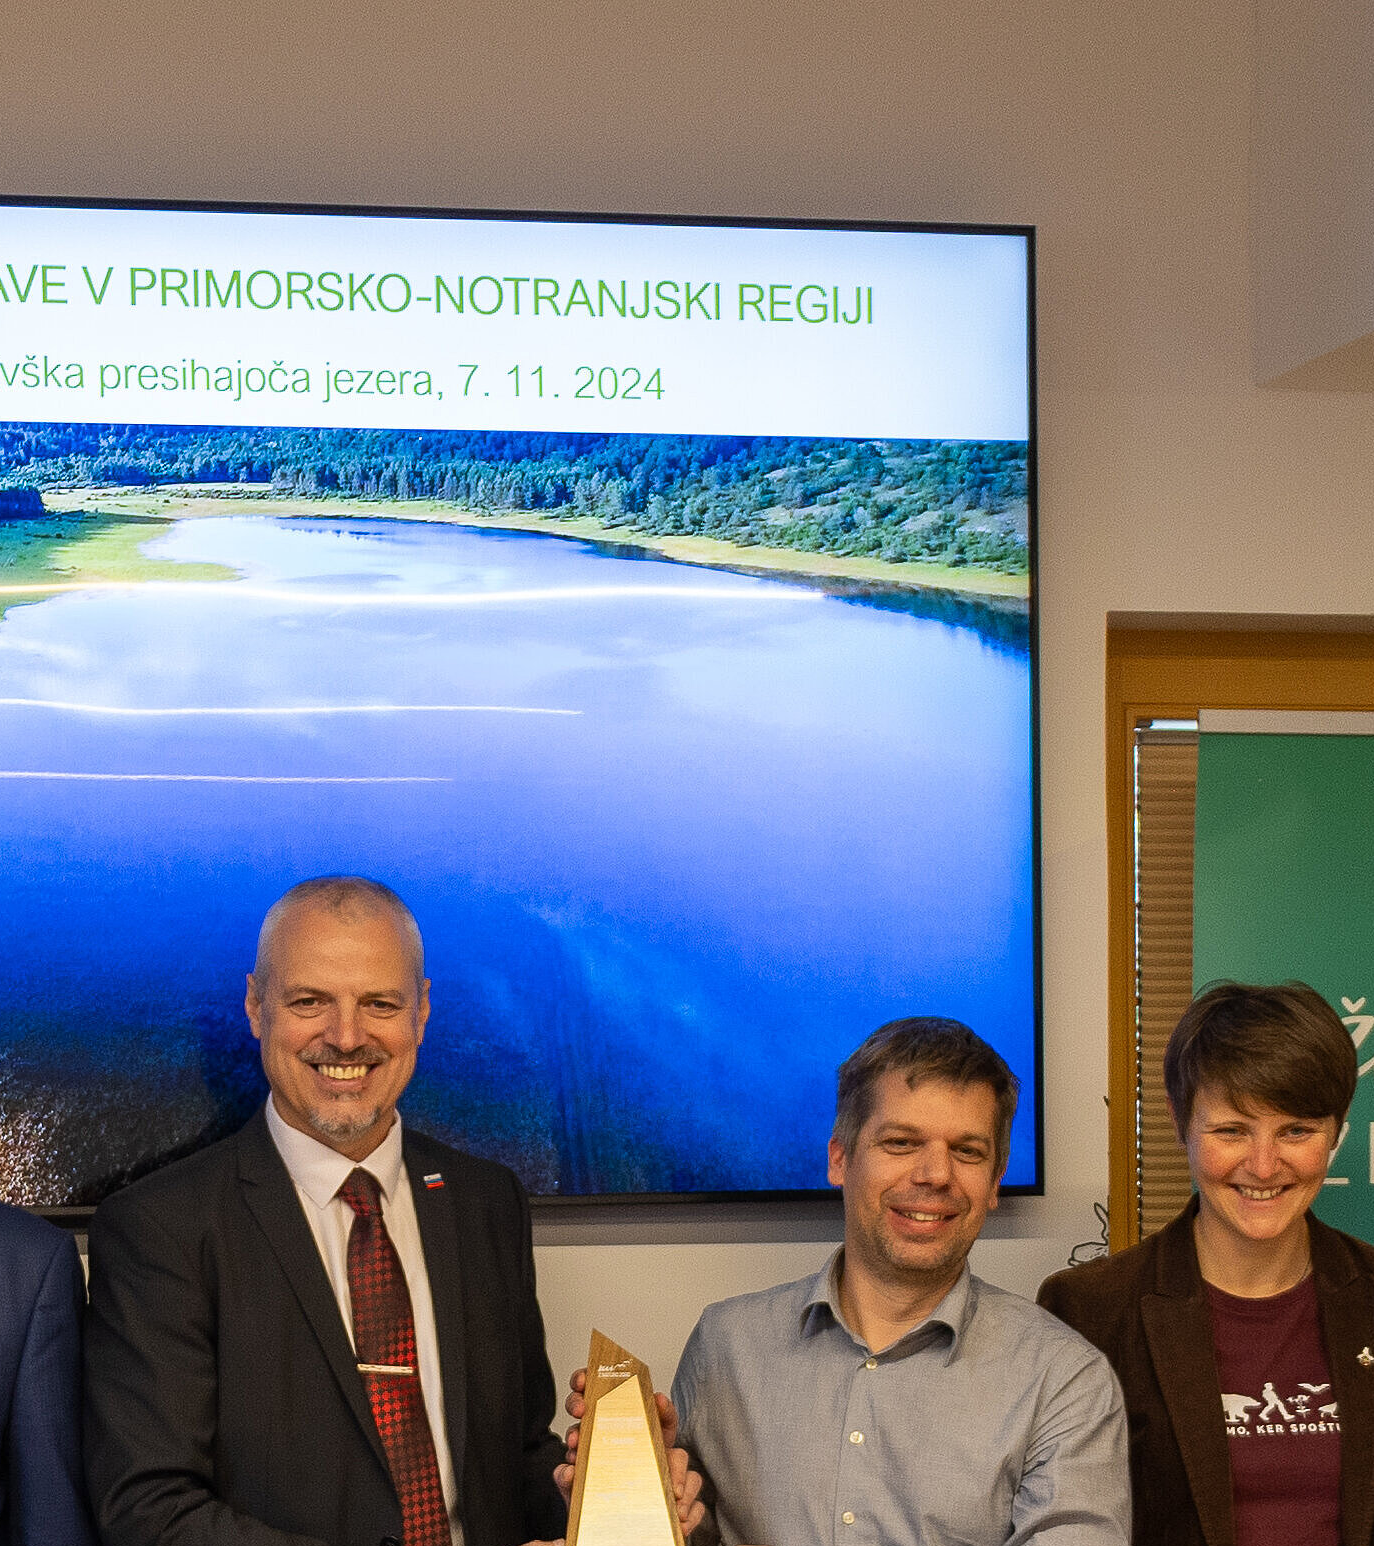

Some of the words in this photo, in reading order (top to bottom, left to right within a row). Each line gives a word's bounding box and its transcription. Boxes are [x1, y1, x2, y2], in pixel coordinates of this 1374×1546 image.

[80, 265, 114, 306] V
[129, 266, 721, 321] PRIMORSKO-NOTRANJSKI
[737, 282, 874, 325] REGIJI
[99, 358, 311, 402] presihajoča
[322, 361, 445, 404] jezera,
[457, 364, 490, 398] 7.
[506, 364, 561, 399] 11.
[573, 365, 666, 401] 2024
[1256, 1423, 1285, 1434] KER
